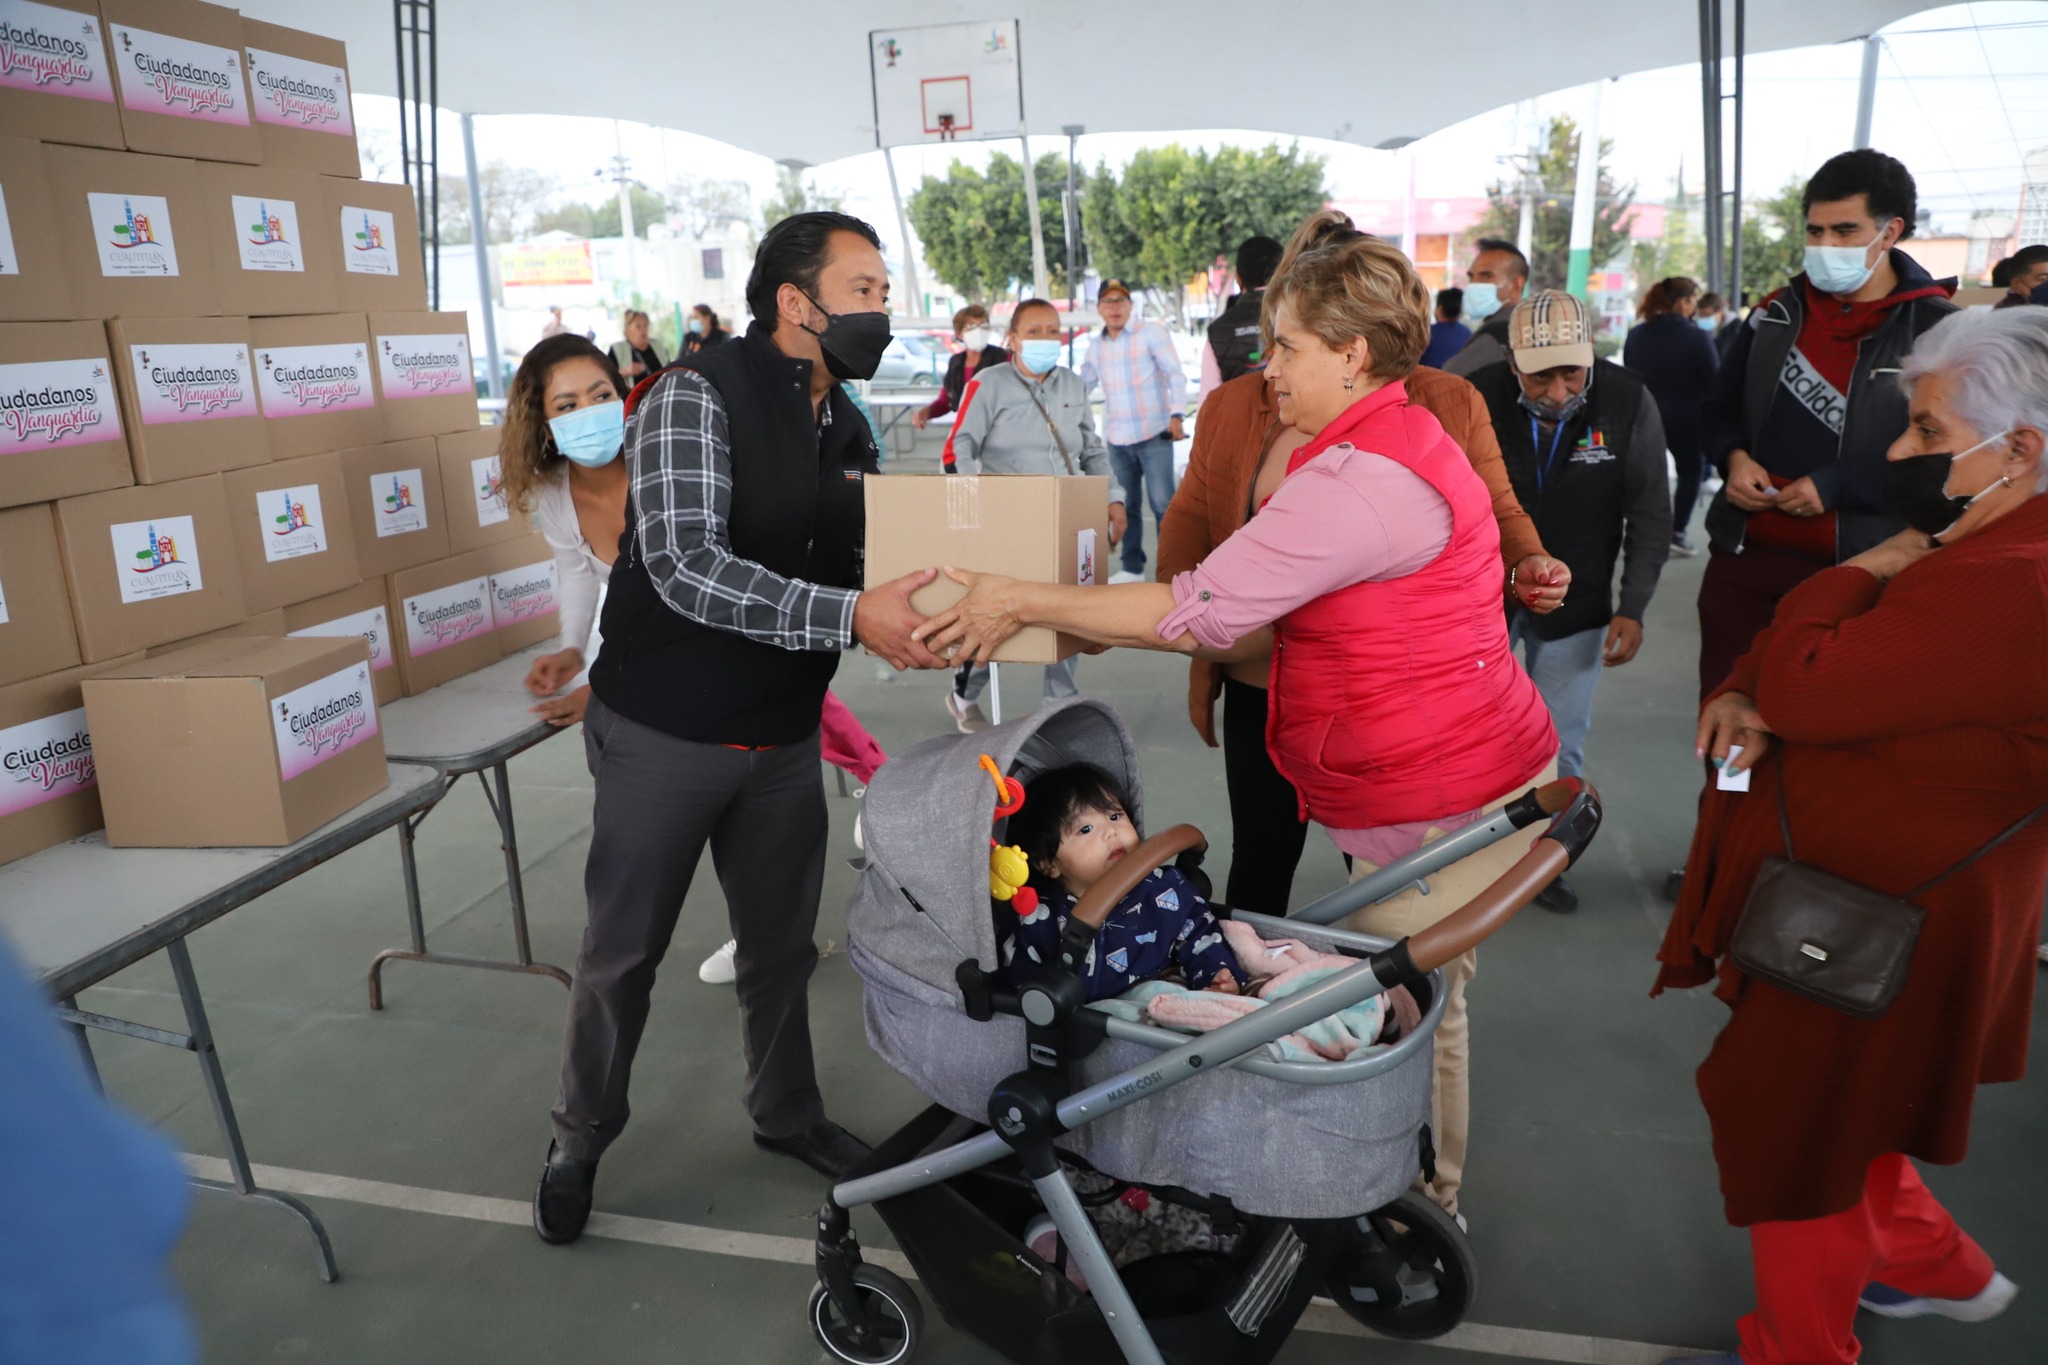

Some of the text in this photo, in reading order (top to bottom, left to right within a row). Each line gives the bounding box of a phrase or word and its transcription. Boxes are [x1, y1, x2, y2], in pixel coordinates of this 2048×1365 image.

[134, 52, 228, 86] Ciudadanos
[155, 74, 231, 110] Vanguardia
[257, 70, 336, 100] Ciudadanos
[273, 89, 337, 122] Vanguardia
[274, 364, 356, 383] Ciudadanos
[392, 352, 458, 367] Ciudadanos
[152, 366, 238, 384] Ciudadanos
[0, 387, 94, 410] udadanos
[170, 383, 240, 412] Vanguardia
[291, 380, 358, 406] Vanguardia
[5, 405, 97, 439] Vanguardia
[497, 578, 551, 600] Ciudadanos
[418, 597, 481, 624] Ciudadanos
[290, 690, 361, 733] Ciudadanos
[305, 709, 364, 751] Vanguardia
[31, 755, 95, 787] Vangu
